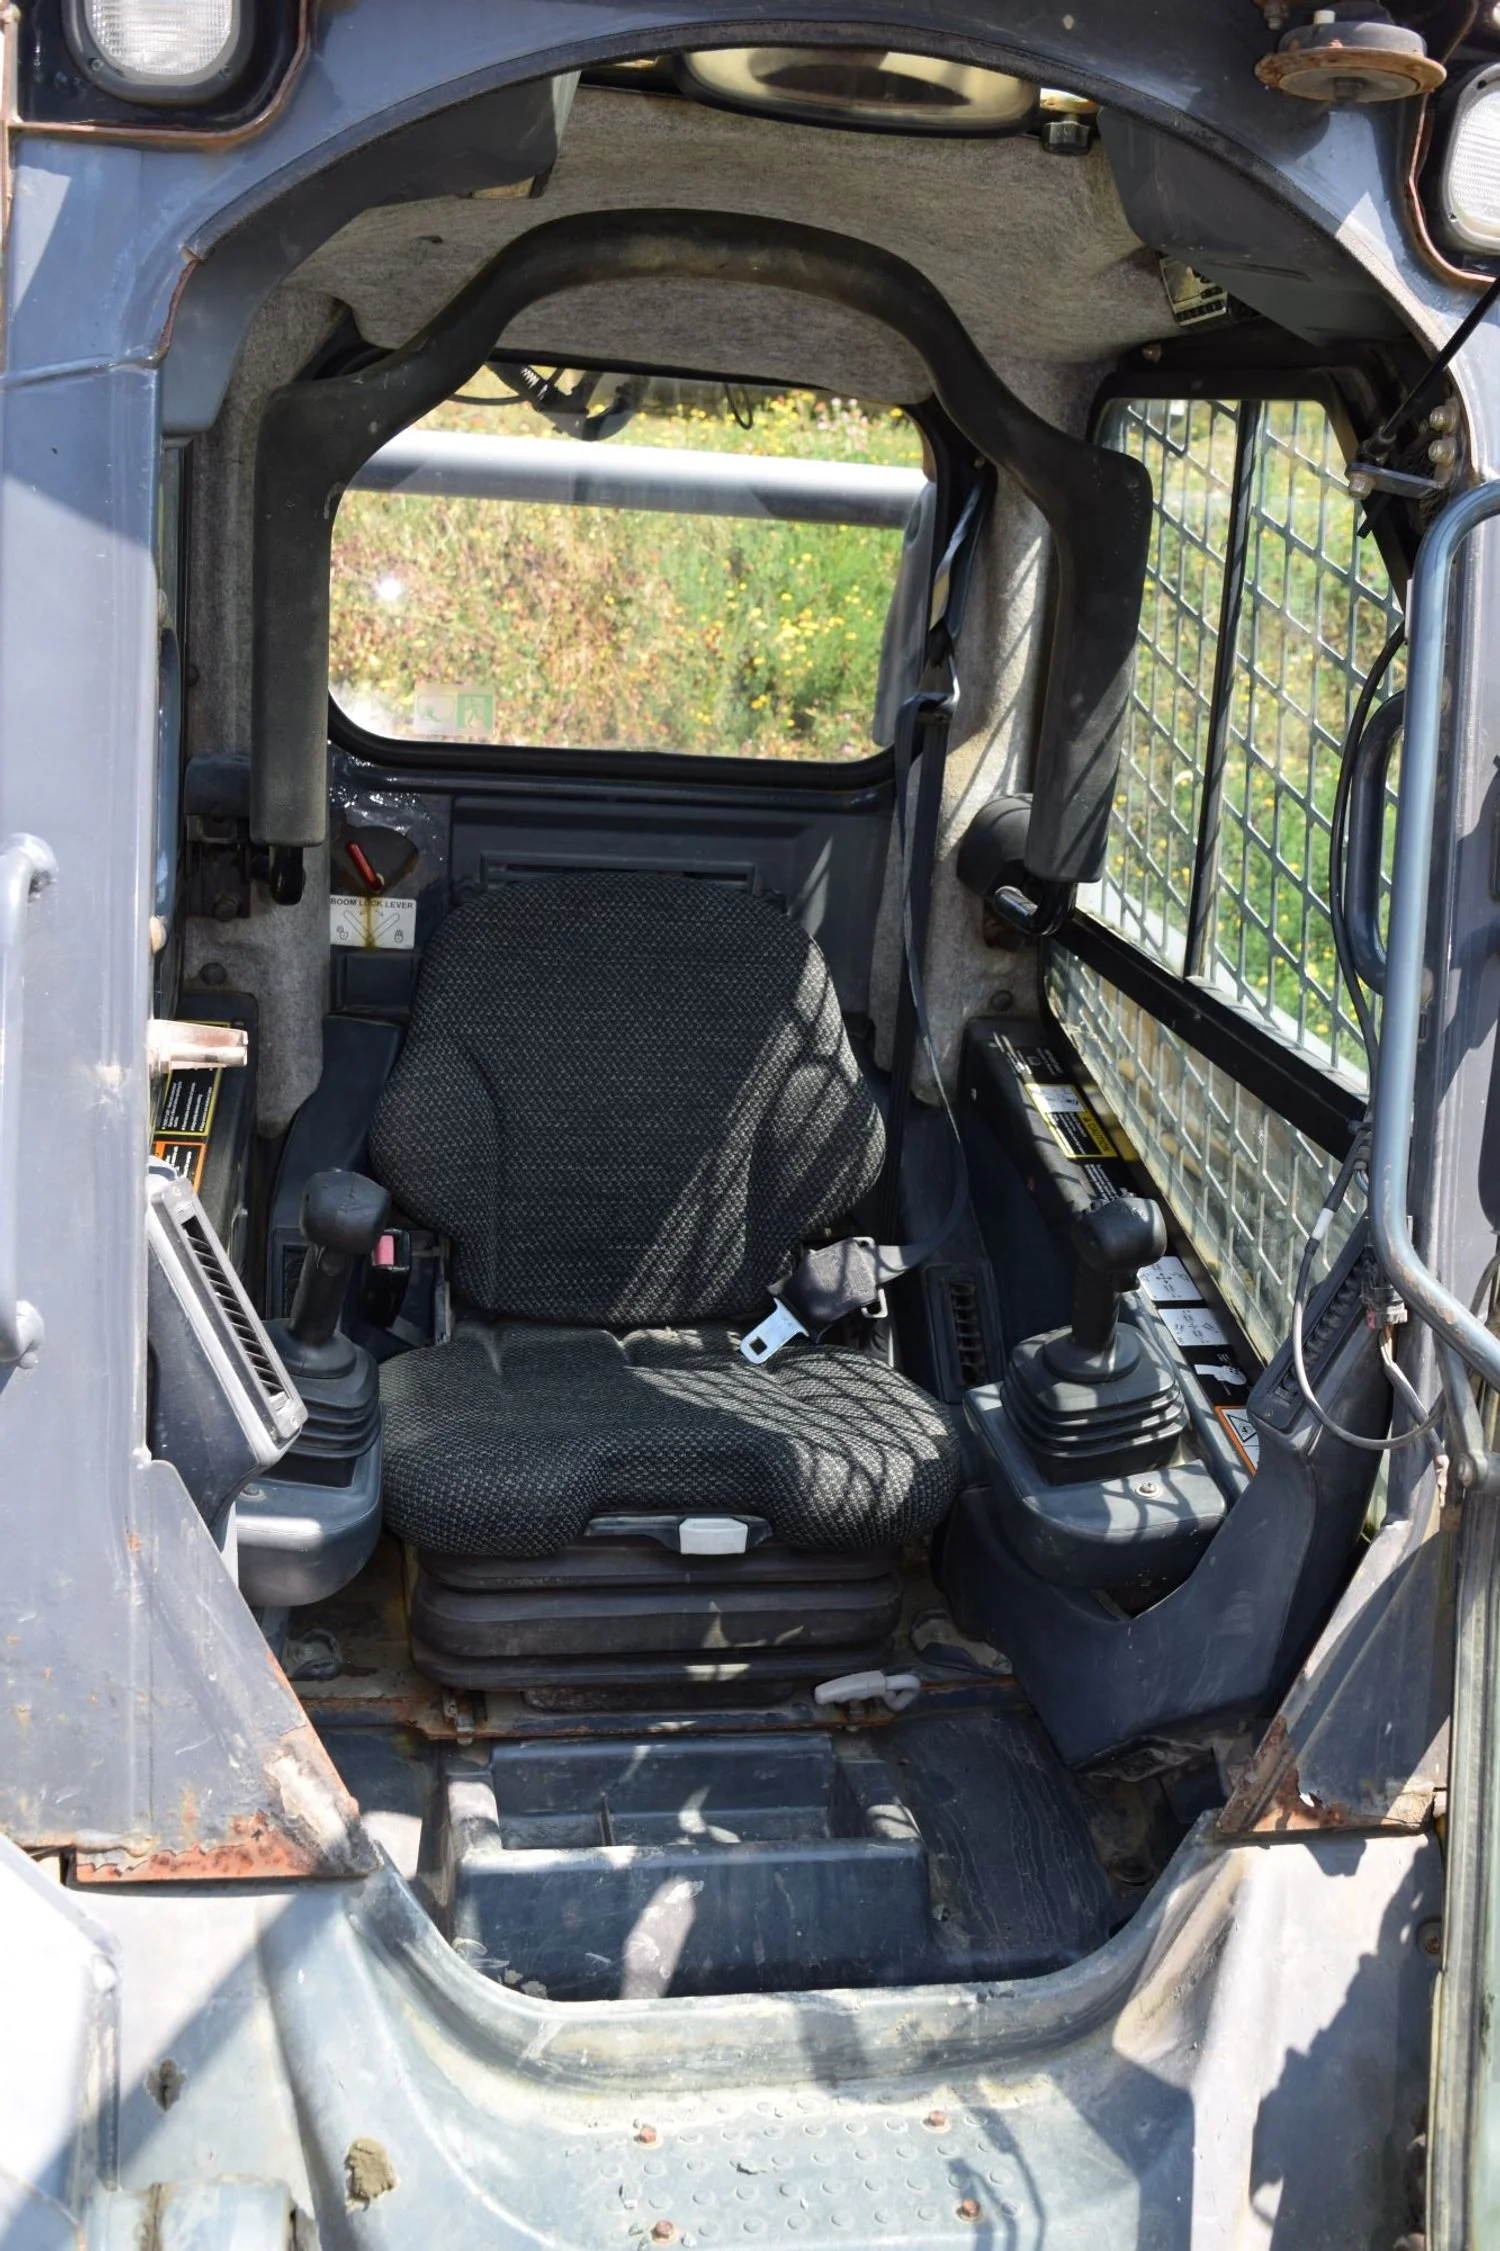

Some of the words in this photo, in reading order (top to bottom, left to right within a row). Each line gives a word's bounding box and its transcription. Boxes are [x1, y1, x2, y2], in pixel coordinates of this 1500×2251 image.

[330, 897, 357, 906] BOOM
[385, 901, 413, 909] LEVER
[1088, 1121, 1112, 1152] CAUTION
